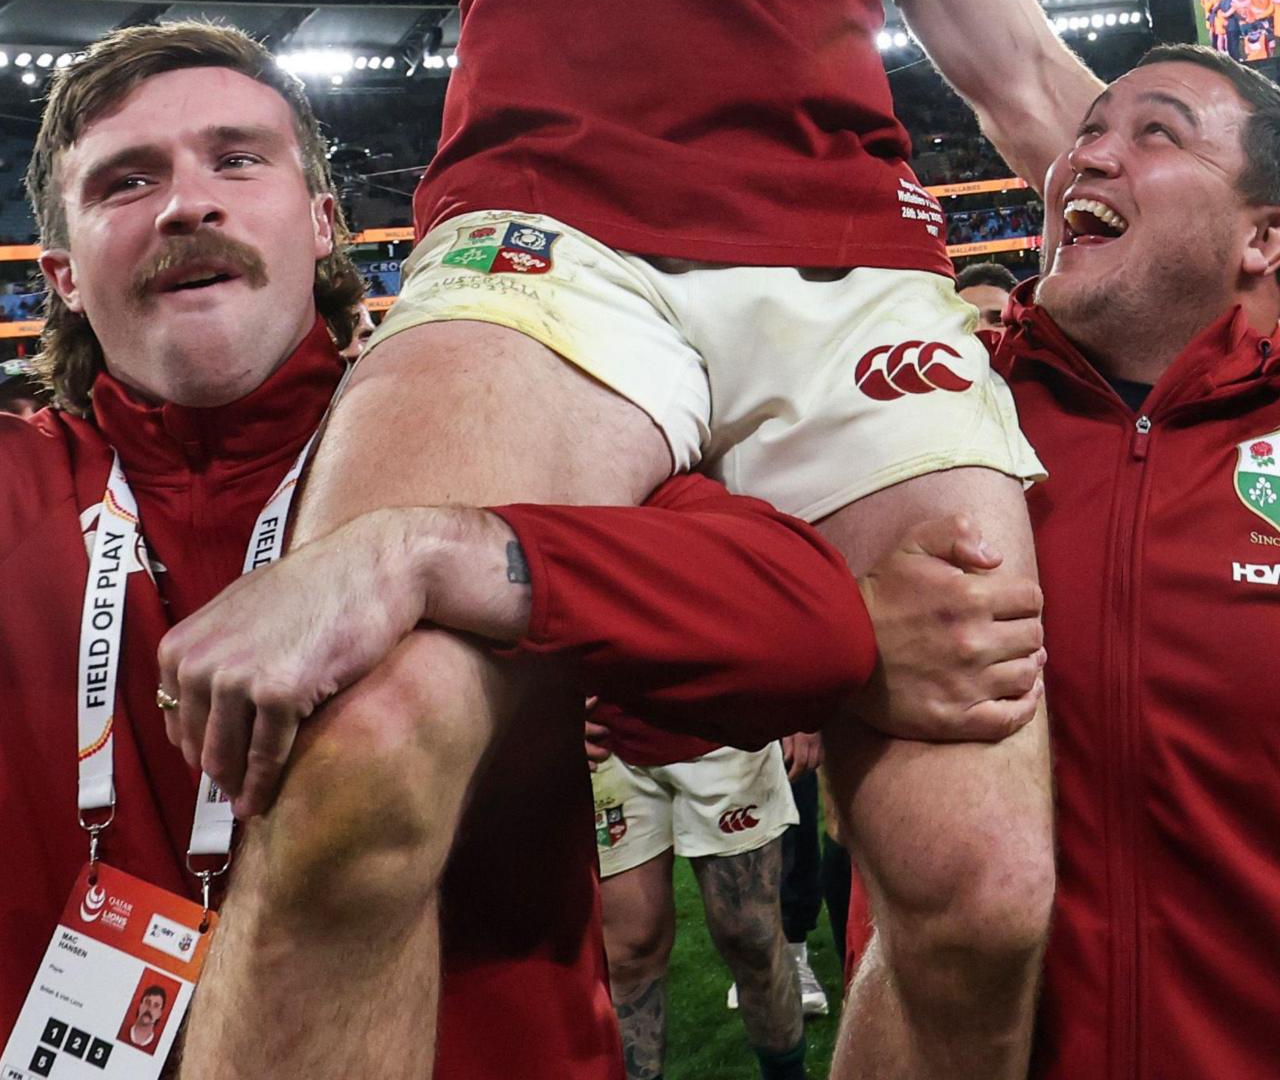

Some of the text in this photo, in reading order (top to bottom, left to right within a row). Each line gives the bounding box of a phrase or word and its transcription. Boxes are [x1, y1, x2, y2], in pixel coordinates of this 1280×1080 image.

[943, 184, 981, 194] WALLABIES
[361, 262, 401, 273] CRO
[86, 531, 126, 708] FIELD OF PLAY
[108, 896, 134, 913] QATAR
[102, 909, 128, 926] LIONS
[61, 931, 78, 944] MAC
[58, 940, 88, 959] HANSEN
[50, 1027, 104, 1060] 1 2 3
